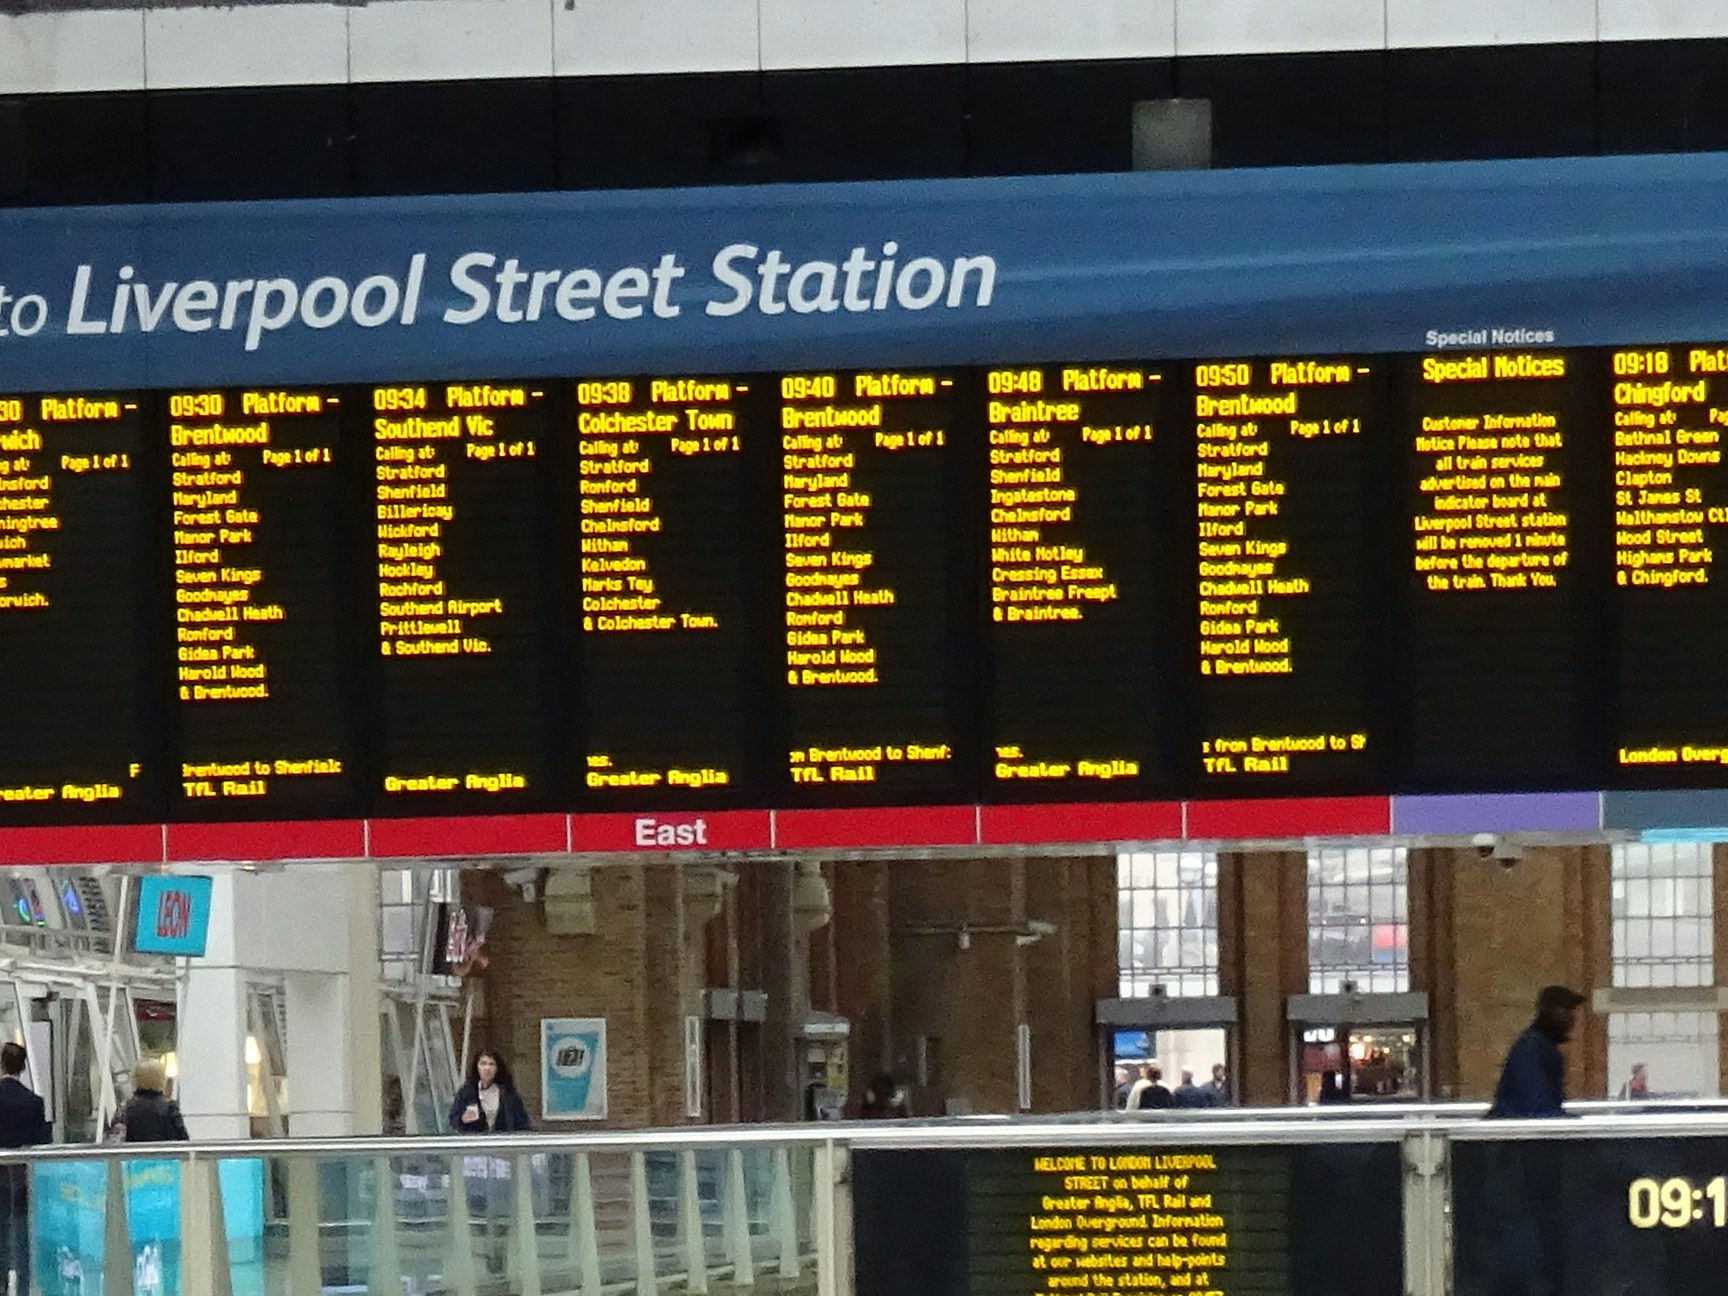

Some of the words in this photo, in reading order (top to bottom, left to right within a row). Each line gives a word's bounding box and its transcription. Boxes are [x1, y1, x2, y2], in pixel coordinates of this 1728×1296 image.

[67, 254, 425, 350] Liverpool
[444, 253, 684, 323] Street
[706, 242, 996, 315] Station
[1426, 329, 1488, 348] Special
[1491, 328, 1555, 345] Notices
[1196, 364, 1249, 386] 09:50
[1271, 362, 1349, 384] Platform
[1422, 356, 1489, 384] Special
[1493, 354, 1565, 378] Notices
[1614, 352, 1668, 375] 09:18
[578, 382, 631, 404] 09:38
[652, 380, 728, 402] Platform
[782, 376, 835, 399] 09:40
[856, 374, 932, 396] Platform
[989, 371, 1042, 393] 09:48
[1063, 369, 1141, 391] Platform
[171, 394, 224, 416] 09:30
[243, 392, 319, 414] Platform
[374, 388, 426, 410] 09:34
[447, 386, 523, 407] Platform
[1197, 392, 1296, 416] Brentwood
[1614, 381, 1706, 406] Chingford
[42, 398, 117, 420] Platform
[782, 405, 881, 428] Brentwood
[989, 401, 1079, 423] Braintree
[171, 422, 269, 445] Brentwood
[374, 415, 462, 440] Southend
[465, 414, 494, 437] Vic
[578, 410, 679, 435] Colchester
[684, 408, 735, 431] Town
[635, 818, 707, 847] East
